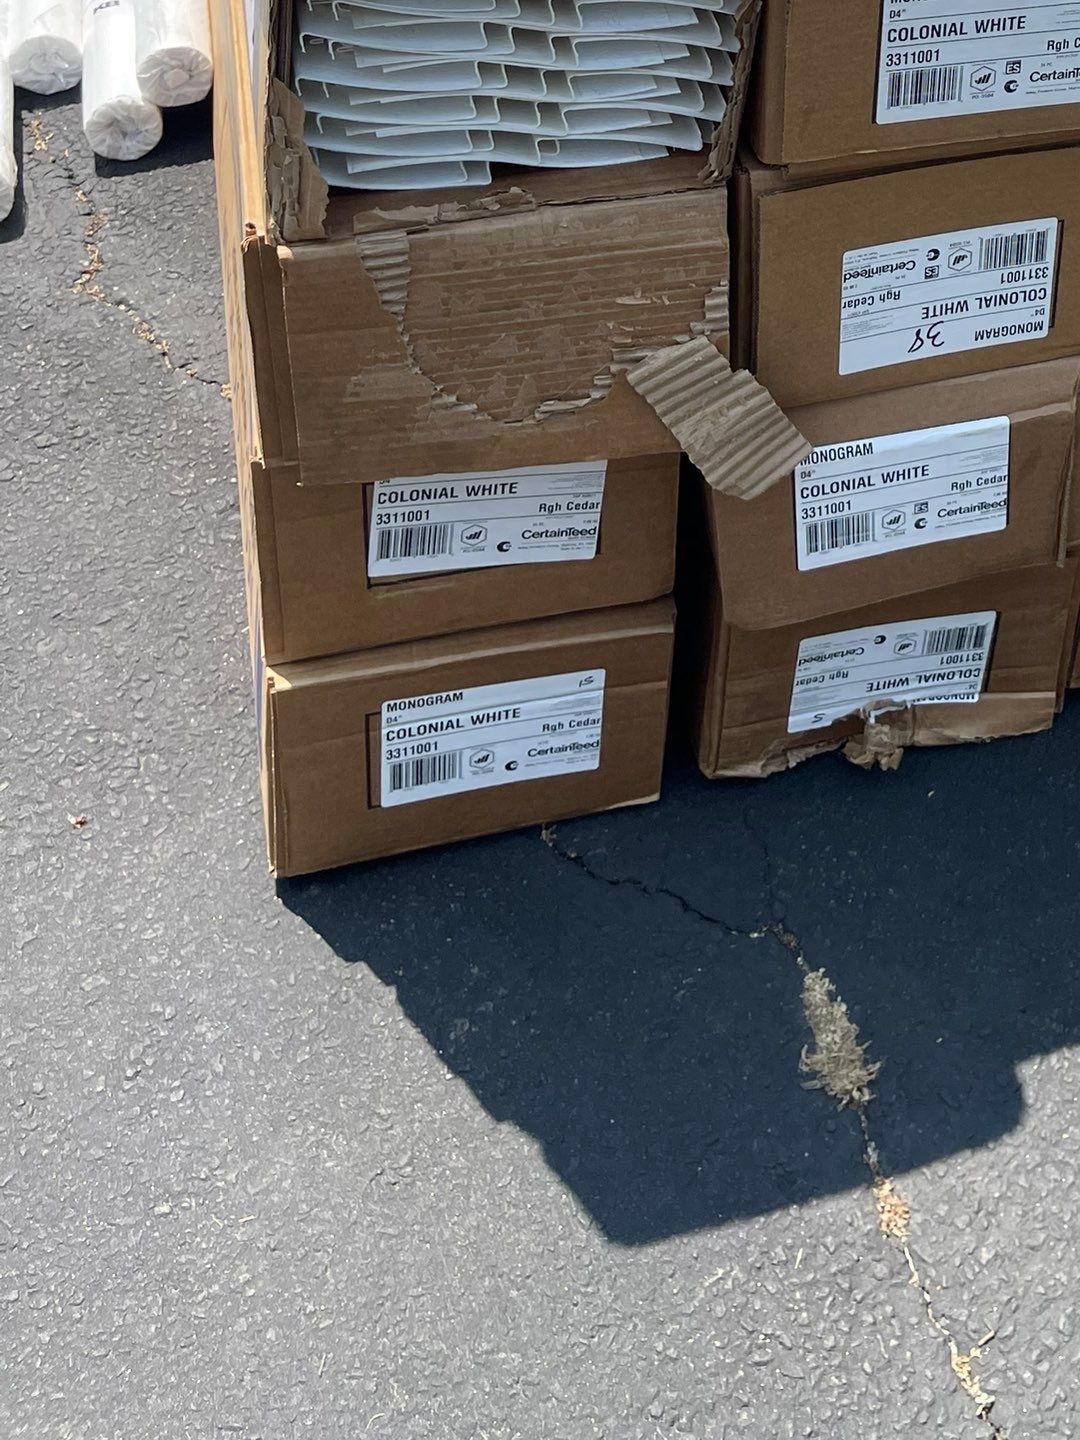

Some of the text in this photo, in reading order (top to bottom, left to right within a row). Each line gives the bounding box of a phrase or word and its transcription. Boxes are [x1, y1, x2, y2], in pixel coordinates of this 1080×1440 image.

[890, 9, 906, 19] D4"
[888, 16, 1026, 43] COLONIAL WHITE
[1047, 40, 1069, 51] Rgh
[886, 49, 940, 67] 3311001
[843, 260, 916, 282] CertainTeed
[1000, 267, 1048, 284] 3311001
[843, 291, 900, 309] Rgh Cedar
[922, 288, 1047, 319] COLONIAL WHITE
[975, 321, 1043, 341] MONOGRAM
[801, 465, 930, 499] COLONIAL WHITE
[951, 475, 1008, 492] Rgh Cedar
[378, 482, 518, 504] COLONIAL WHITE
[539, 500, 600, 513] Rgh Cedar
[801, 500, 851, 519] 3311001
[937, 500, 1007, 518] CertainTeed
[376, 510, 430, 525] 3311001
[522, 527, 596, 539] CertainTeed
[799, 647, 864, 666] CertainTeed
[940, 652, 984, 665] 3311001
[796, 671, 849, 686] Rgh Cedar
[866, 668, 981, 692] COLONIAL WHITE
[387, 692, 463, 712] MONOGRAM
[386, 708, 520, 741] COLONIAL WHITE
[542, 718, 600, 733] Rgh Cedar
[386, 741, 438, 760] 3311001
[528, 739, 600, 758] CertainTeed
